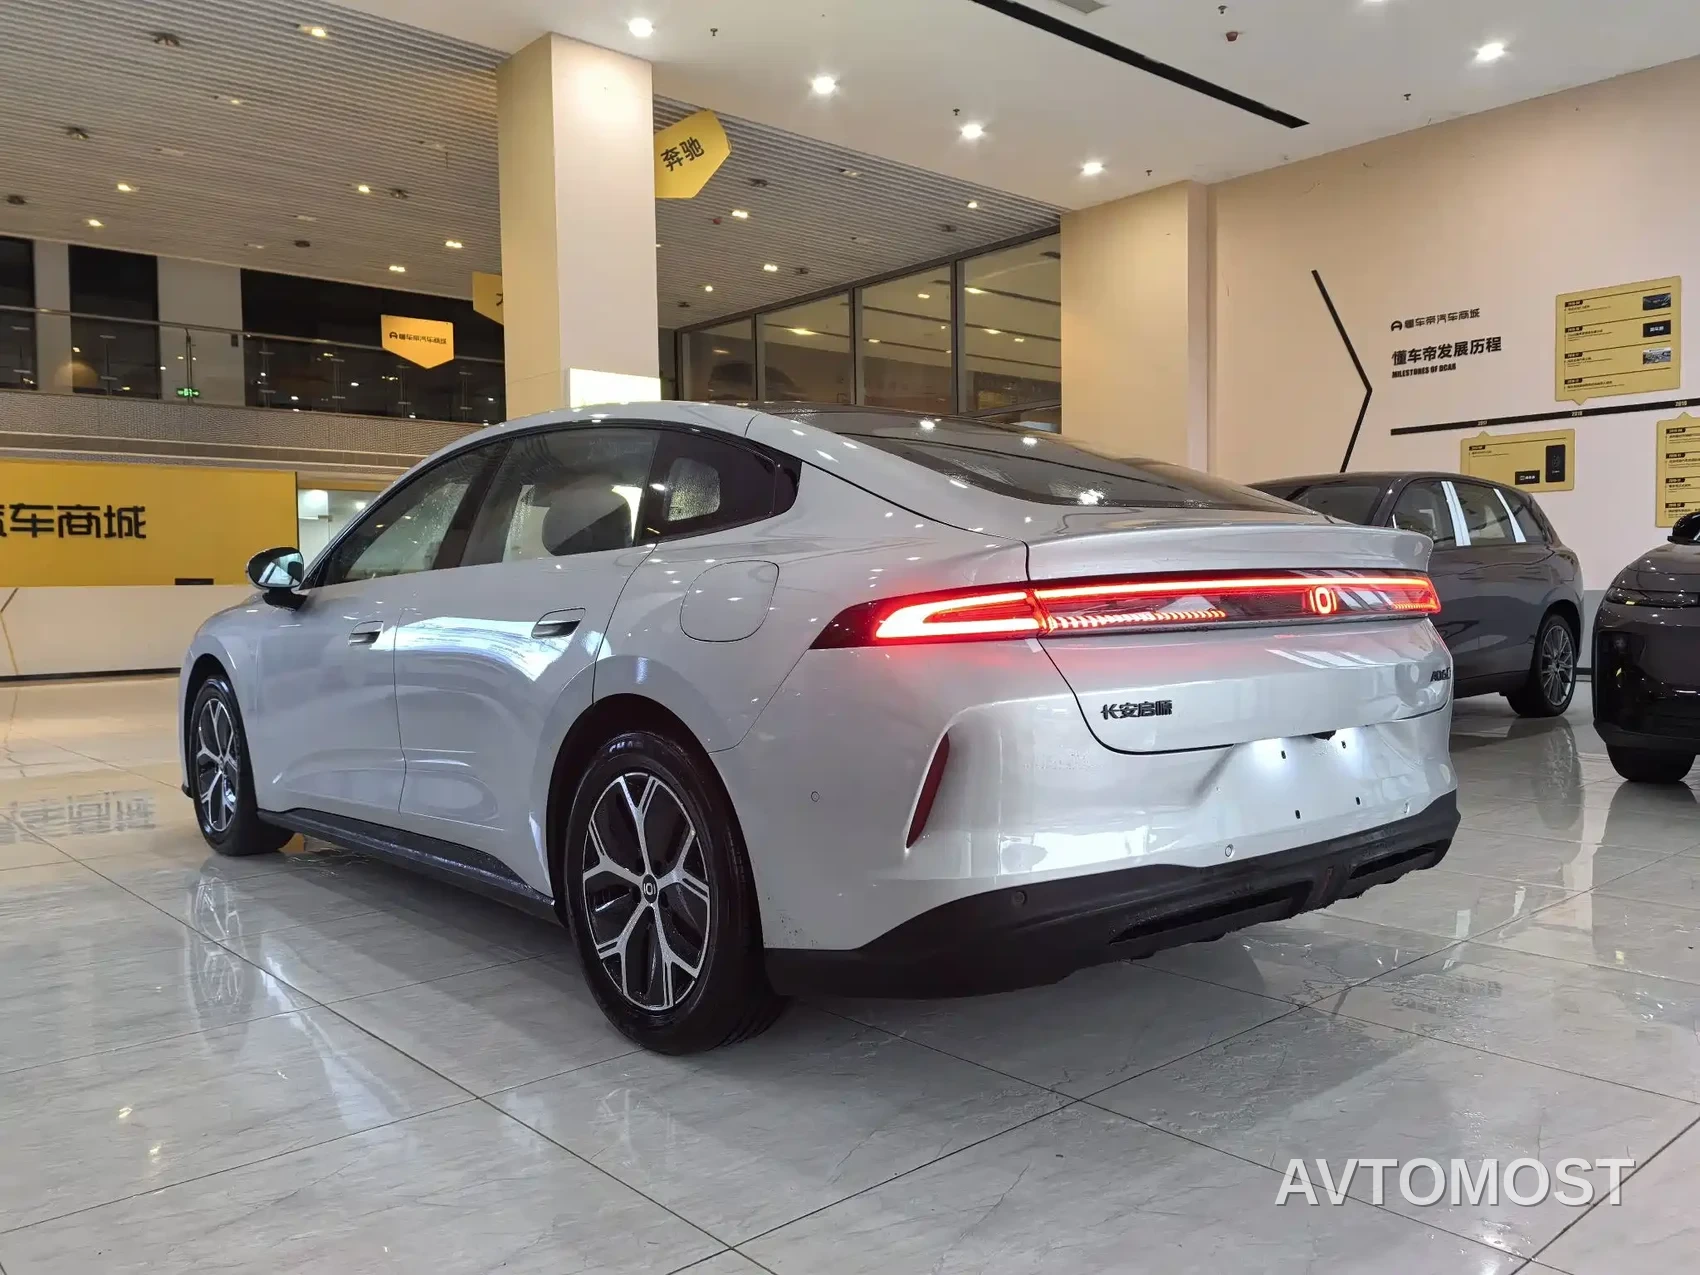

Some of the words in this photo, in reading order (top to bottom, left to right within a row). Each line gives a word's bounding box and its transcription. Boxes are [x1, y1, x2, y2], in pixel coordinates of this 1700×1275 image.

[660, 136, 705, 172] 奔驰
[1391, 336, 1501, 365] 懂车帝发展历程
[1430, 365, 1438, 374] OF
[0, 502, 147, 539] 车商城
[1100, 699, 1173, 720] 长安启源
